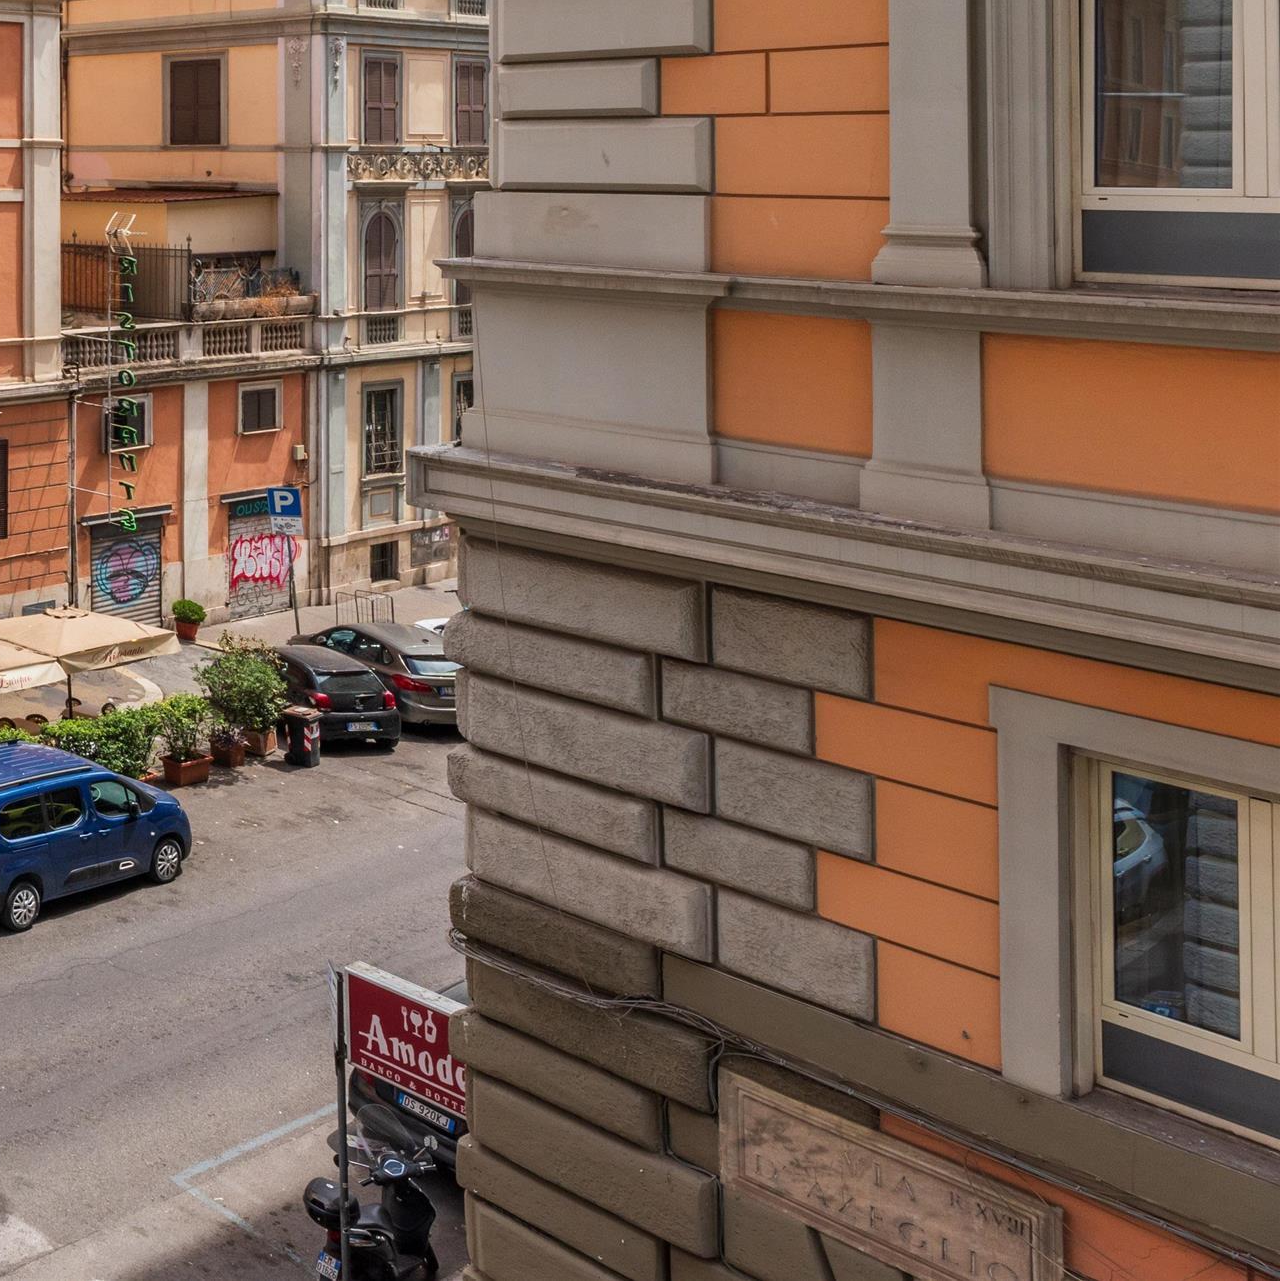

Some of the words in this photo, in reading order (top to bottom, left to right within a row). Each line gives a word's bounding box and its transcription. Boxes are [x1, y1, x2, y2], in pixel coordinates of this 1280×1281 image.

[273, 490, 294, 513] P
[360, 1057, 401, 1083] BANCO
[409, 1081, 417, 1090] &
